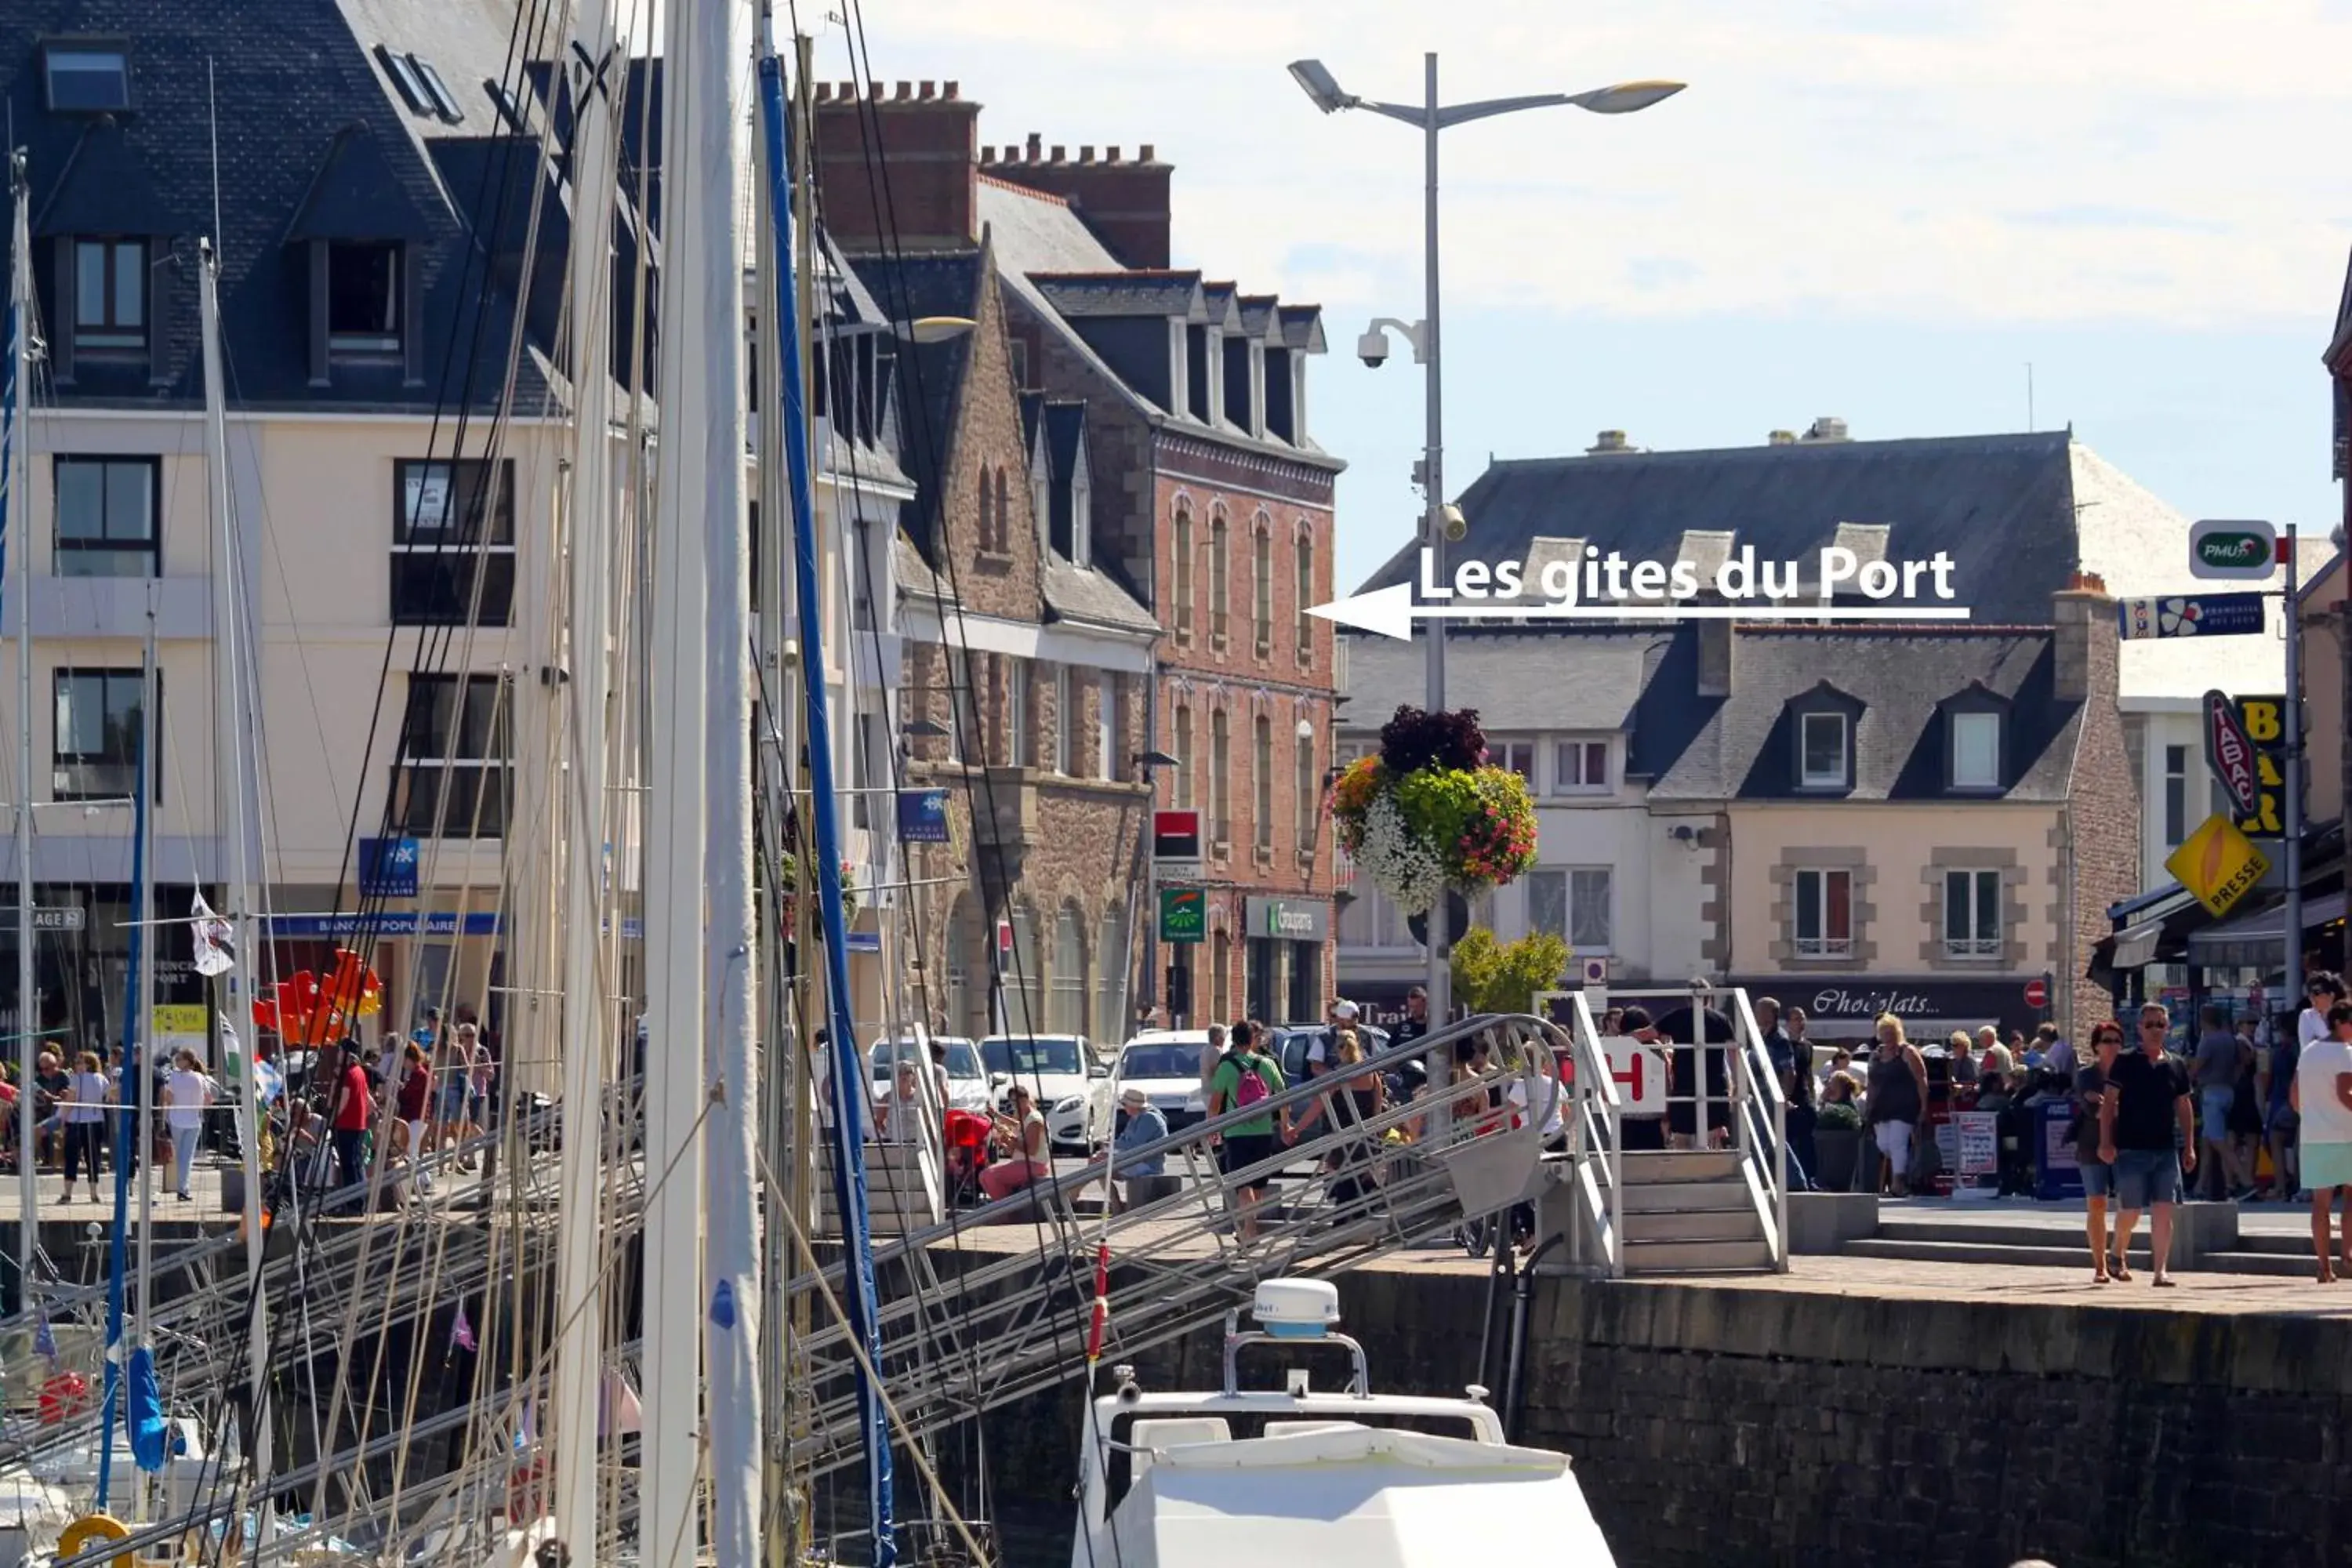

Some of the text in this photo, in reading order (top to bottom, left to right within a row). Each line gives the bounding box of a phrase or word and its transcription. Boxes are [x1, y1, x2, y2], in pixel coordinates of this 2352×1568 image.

[2204, 544, 2238, 557] PMU
[2214, 707, 2252, 801] TABAC
[2241, 701, 2283, 833] BAR
[2210, 855, 2264, 909] PRESSE
[380, 920, 456, 931] POPUAIRE
